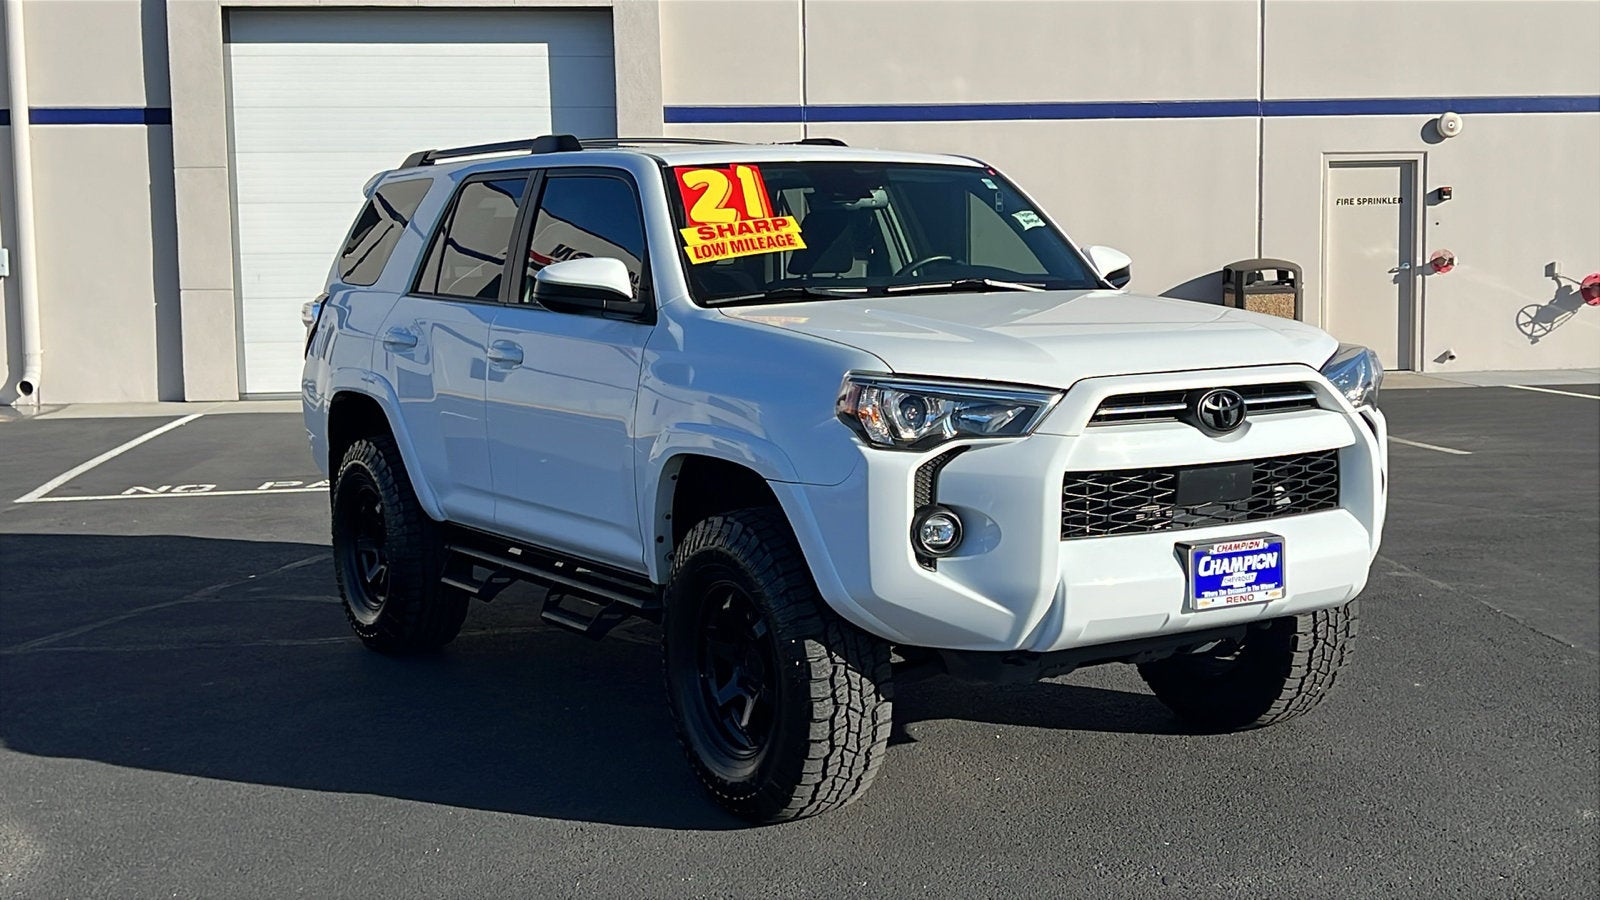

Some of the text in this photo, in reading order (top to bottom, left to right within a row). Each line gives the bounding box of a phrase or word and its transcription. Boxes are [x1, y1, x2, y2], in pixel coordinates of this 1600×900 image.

[682, 165, 766, 223] 21
[1336, 197, 1404, 206] FIRE SPRINKLER
[697, 218, 790, 241] SHARP
[693, 233, 795, 259] LOW MILEAGE
[121, 484, 217, 495] NO
[1216, 540, 1261, 553] CHAMPION
[1198, 552, 1278, 577] CHAMPION
[1226, 593, 1255, 604] RENO
